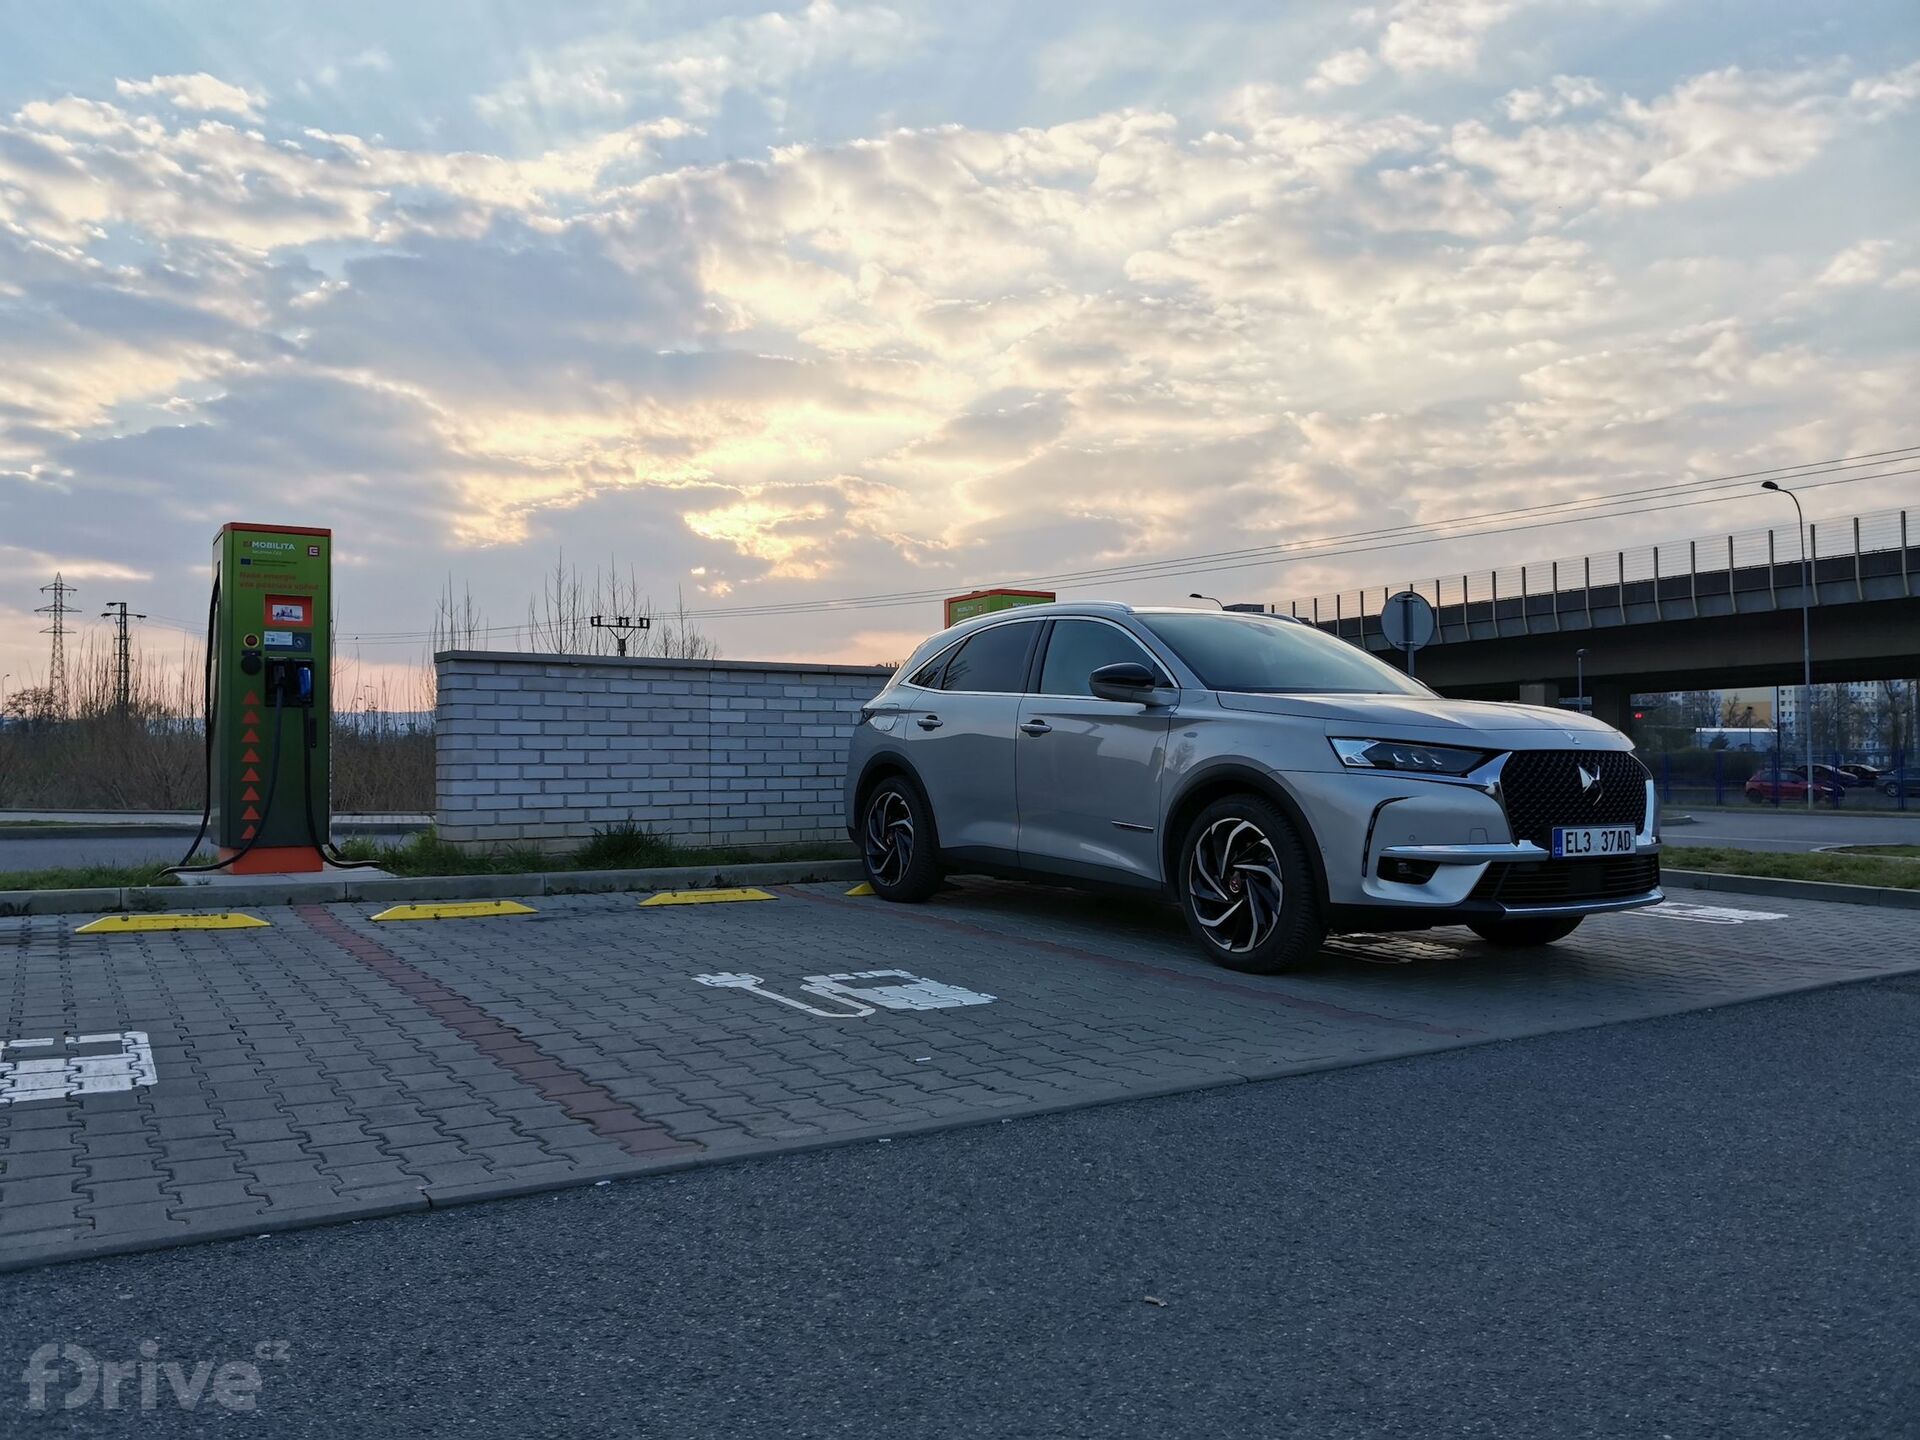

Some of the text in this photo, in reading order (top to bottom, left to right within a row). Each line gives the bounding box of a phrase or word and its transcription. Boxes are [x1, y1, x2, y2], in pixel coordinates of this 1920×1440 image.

[251, 541, 295, 550] MOBILITA
[1566, 831, 1631, 853] EL3 37AD
